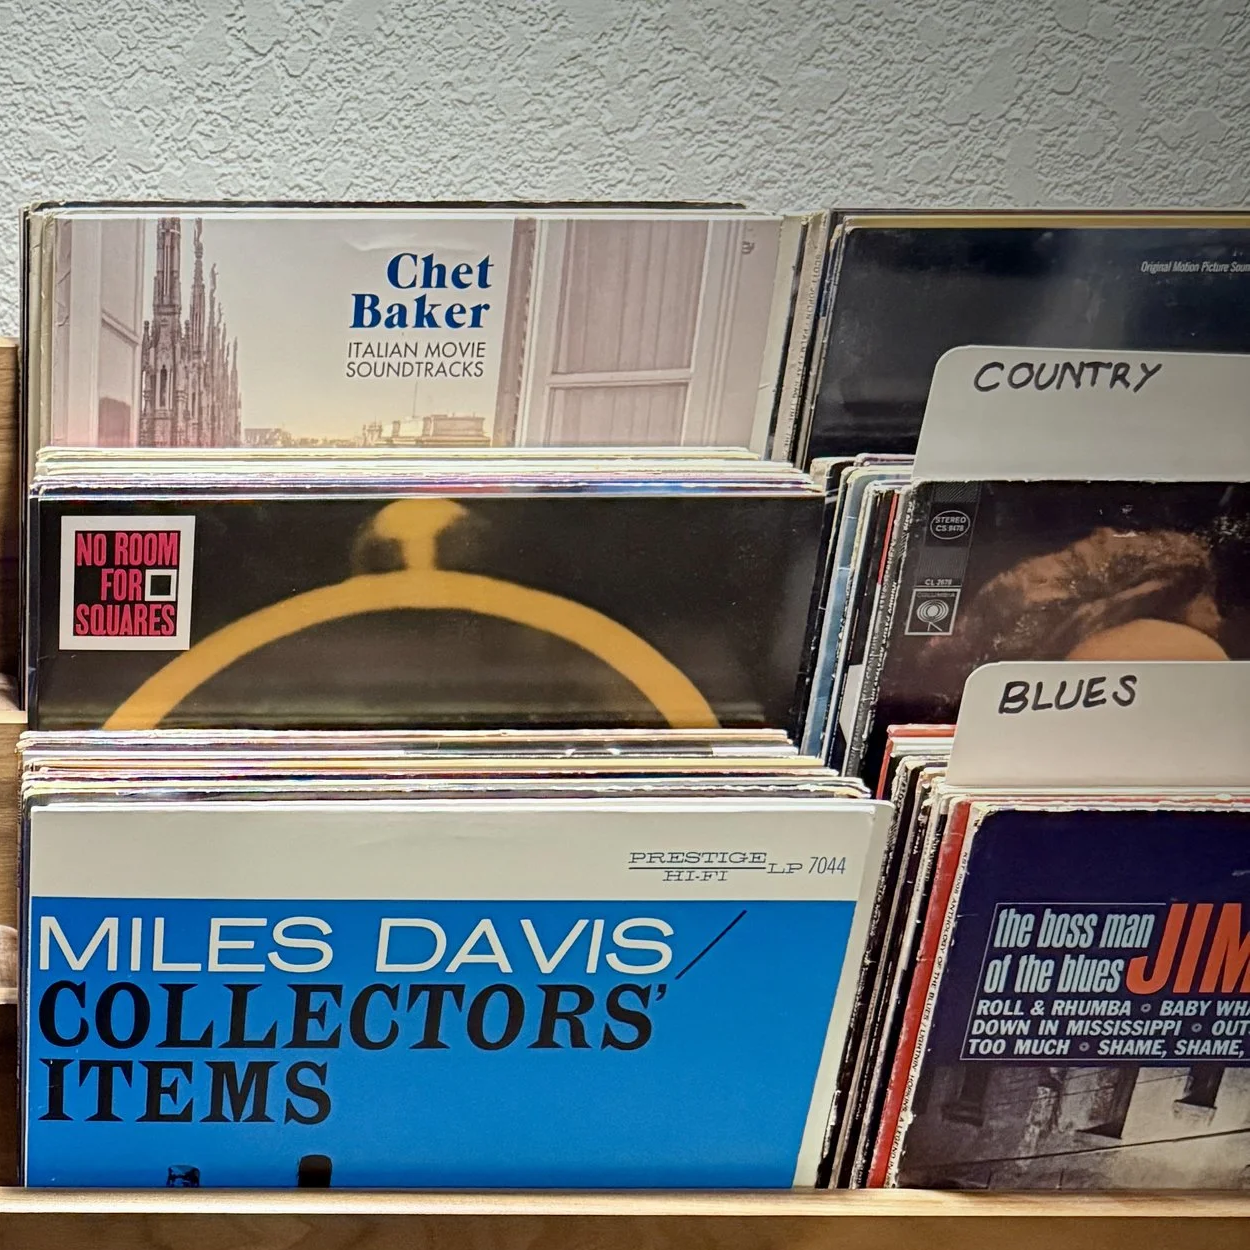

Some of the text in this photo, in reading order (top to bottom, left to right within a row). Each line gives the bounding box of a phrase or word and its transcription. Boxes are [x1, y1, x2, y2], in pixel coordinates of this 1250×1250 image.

[387, 251, 495, 290] Chet
[1141, 260, 1172, 274] Original
[1172, 260, 1200, 272] Motion
[1201, 261, 1229, 272] Picture
[350, 292, 491, 329] Baker
[347, 341, 487, 359] ITALIAN MOVIE
[345, 360, 485, 378] SOUNDTRACKS
[973, 359, 1163, 393] COUNTRY
[935, 516, 967, 525] STEREO
[76, 531, 178, 567] NO ROOM
[100, 569, 142, 602] FOR
[75, 604, 176, 637] SQUARES
[999, 675, 1138, 714] BLUES
[627, 852, 768, 864] PRESTIGE
[767, 856, 847, 875] LP 7044
[662, 870, 729, 881] HI-FI
[938, 896, 957, 954] ANTHOLOGY
[993, 908, 1156, 949] the boss man
[38, 915, 334, 973] MILES
[935, 955, 944, 969] OF
[983, 954, 1124, 994] of the blues
[930, 970, 940, 989] THE
[37, 980, 668, 1052] COLLECTORS'
[922, 991, 935, 1021] BLUES
[977, 999, 1025, 1016] ROLL
[1030, 999, 1045, 1016] &
[1051, 999, 1131, 1017] RHUMBA
[1159, 1000, 1212, 1017] BABY
[972, 1019, 1032, 1037] DOWN
[1038, 1019, 1055, 1036] IN
[1065, 1019, 1183, 1037] MISSISSIPPI
[968, 1038, 1245, 1058] TOO MUCH SHAME, SHAME,
[37, 1058, 333, 1126] ITEMS
[889, 1124, 904, 1159] LEGEND
